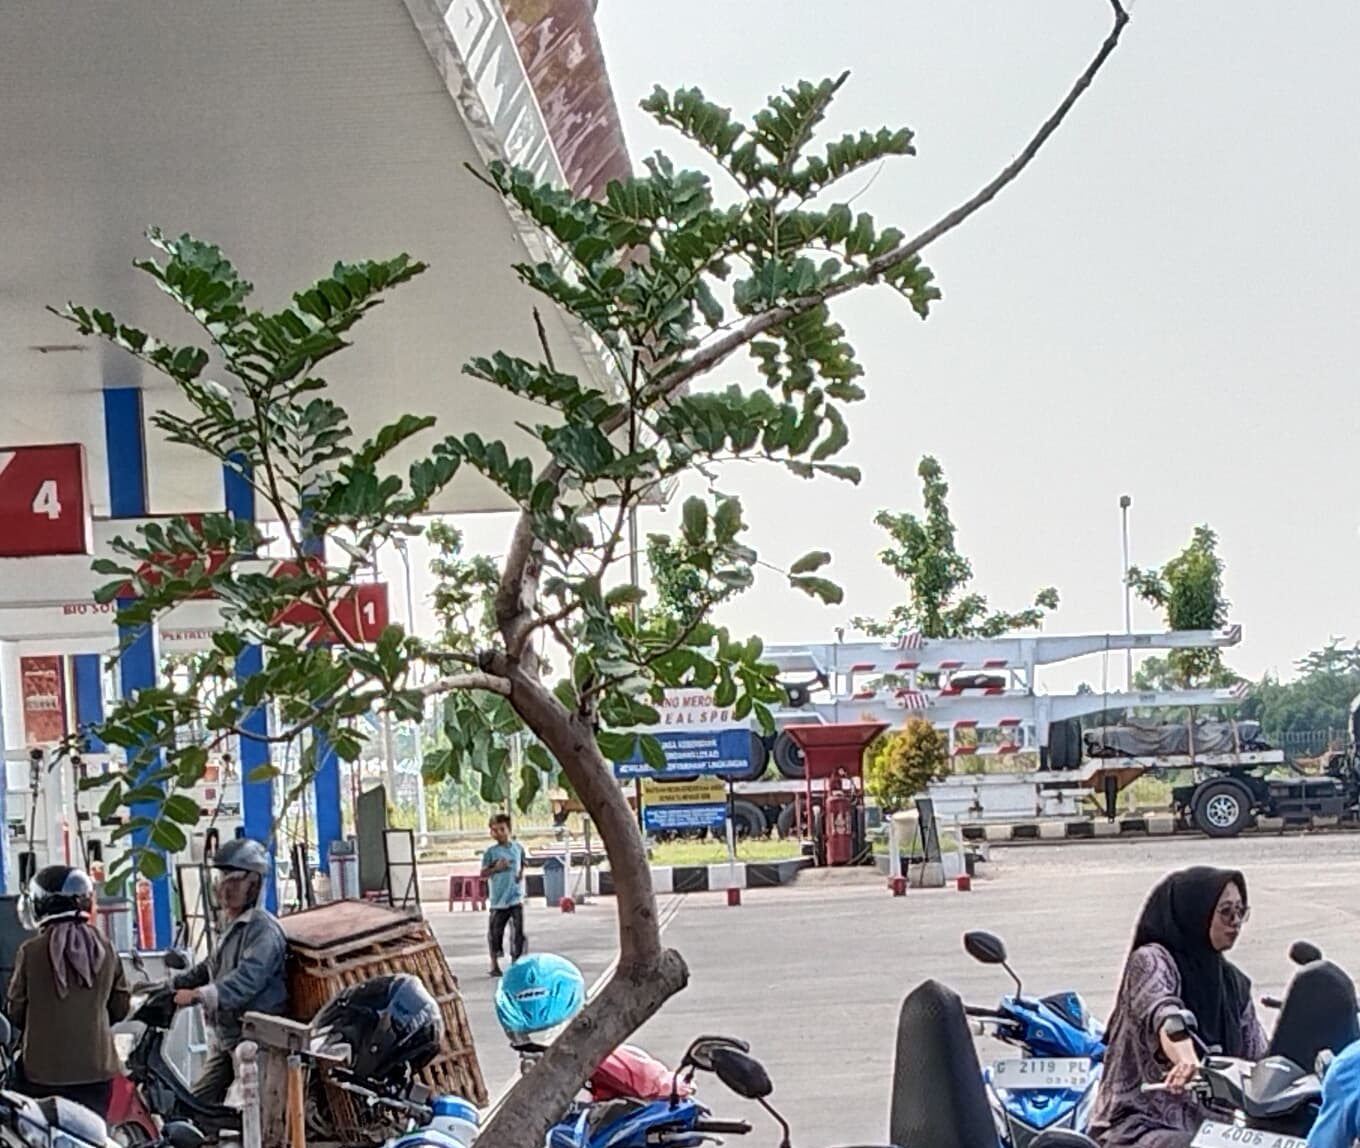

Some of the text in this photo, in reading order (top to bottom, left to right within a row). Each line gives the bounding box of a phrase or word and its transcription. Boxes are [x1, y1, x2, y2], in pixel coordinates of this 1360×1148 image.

[31, 480, 62, 520] 4
[362, 601, 377, 625] 1
[1019, 1061, 1056, 1074] 2119
